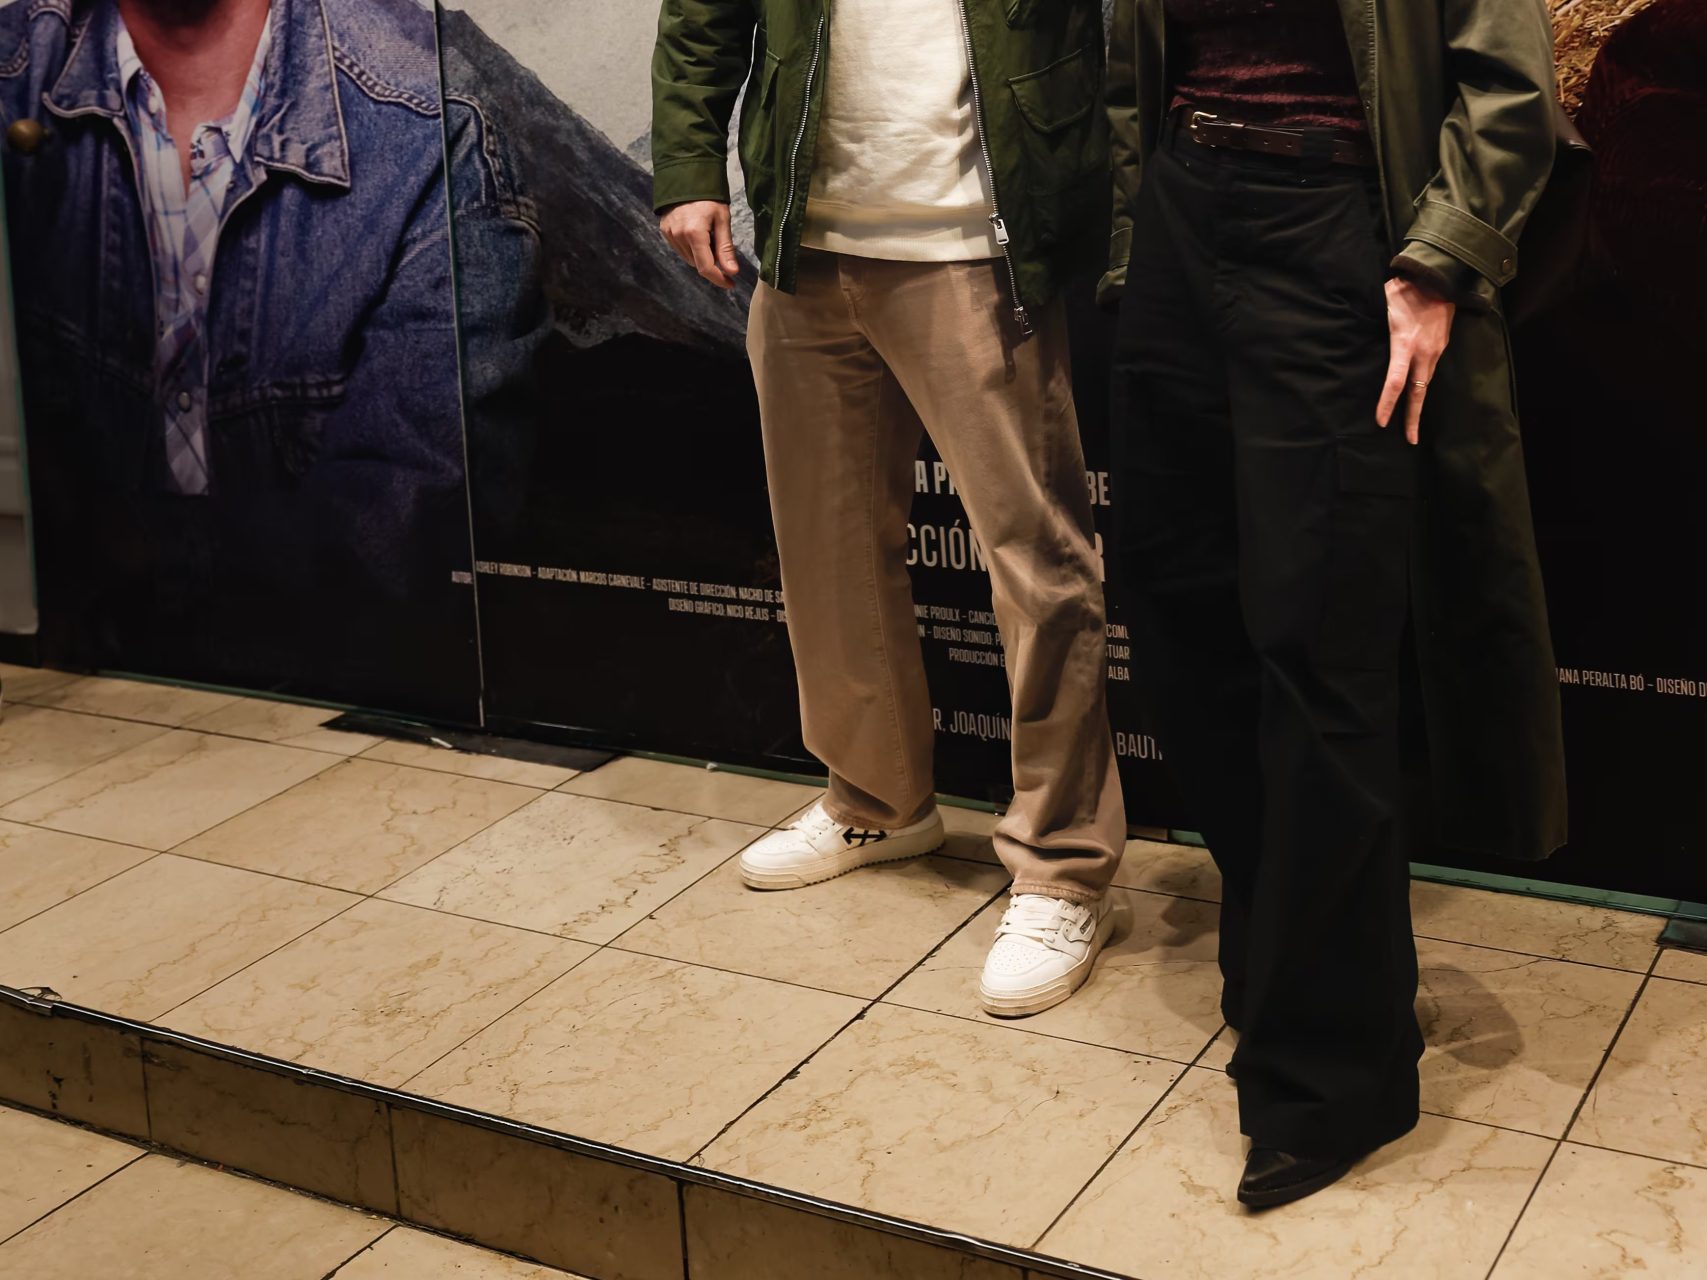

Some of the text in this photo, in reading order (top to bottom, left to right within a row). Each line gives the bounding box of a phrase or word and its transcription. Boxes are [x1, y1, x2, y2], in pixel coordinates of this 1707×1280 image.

[652, 577, 688, 594] ASISTENTE
[689, 581, 700, 595] DE
[738, 586, 763, 602] NACHO
[764, 589, 774, 603] DE
[726, 604, 743, 619] NICO
[930, 606, 960, 622] PROULX
[949, 647, 999, 667] PRODUCCIÓN
[1108, 665, 1131, 681] ALBA
[1582, 670, 1628, 690] PERALTA
[1630, 673, 1645, 692] BÓ
[1656, 677, 1696, 697] DISEÑO
[949, 709, 1012, 742] JOAQUÍN
[1116, 731, 1163, 761] BAUT
